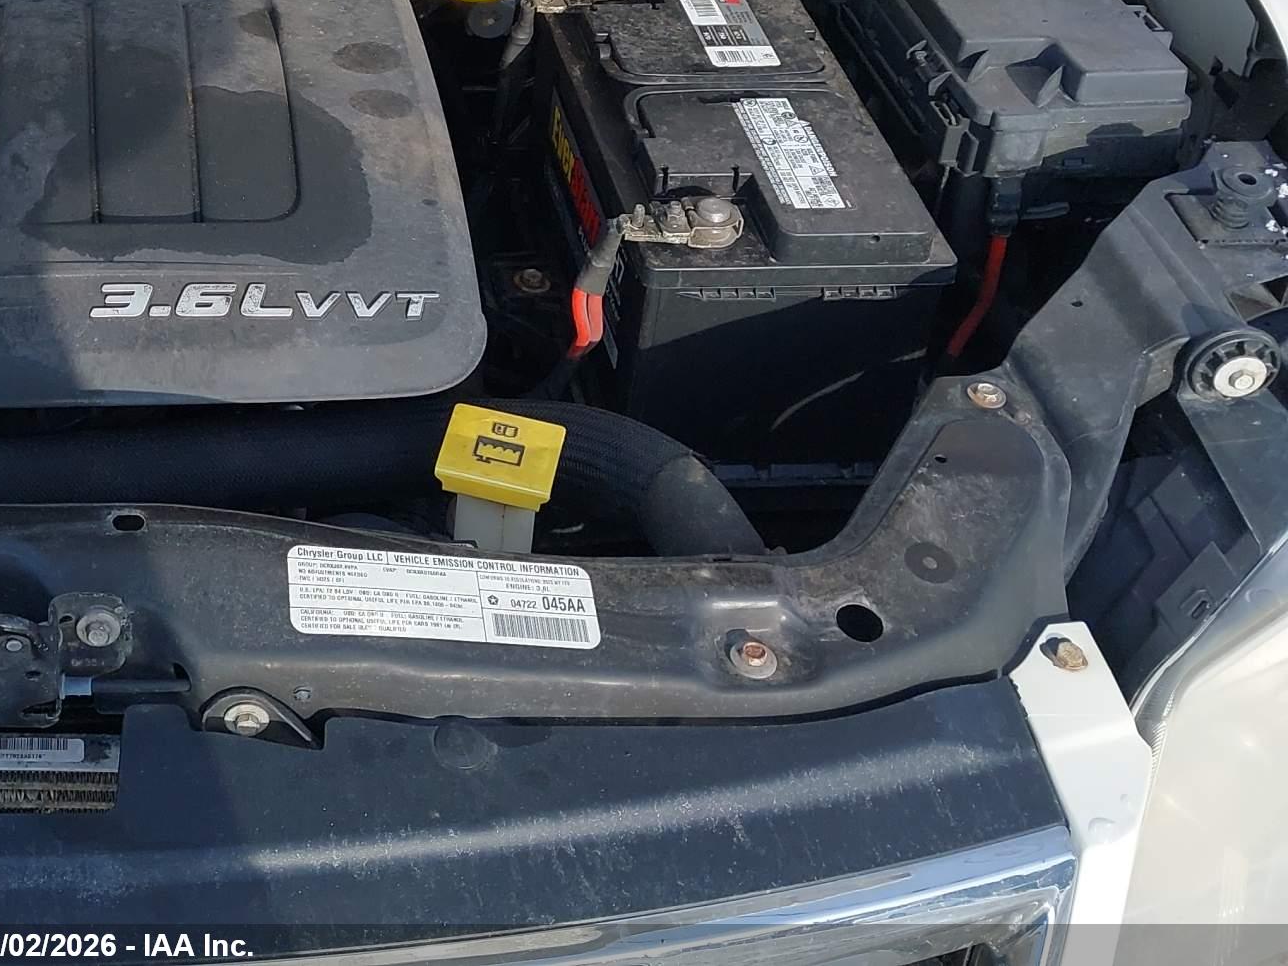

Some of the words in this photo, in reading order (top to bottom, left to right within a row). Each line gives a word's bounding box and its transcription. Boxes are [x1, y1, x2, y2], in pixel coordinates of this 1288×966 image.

[89, 283, 293, 318] 3.6L
[295, 291, 440, 319] VVT
[297, 547, 333, 558] Chrysler
[337, 550, 363, 561] Group
[366, 552, 383, 562] LLC
[394, 554, 430, 565] VEHICLE
[433, 557, 474, 569] EMISSION
[477, 561, 516, 572] CONTROL
[519, 564, 579, 576] INFORMATION
[511, 599, 537, 609] 04722
[542, 596, 586, 613] 045AA
